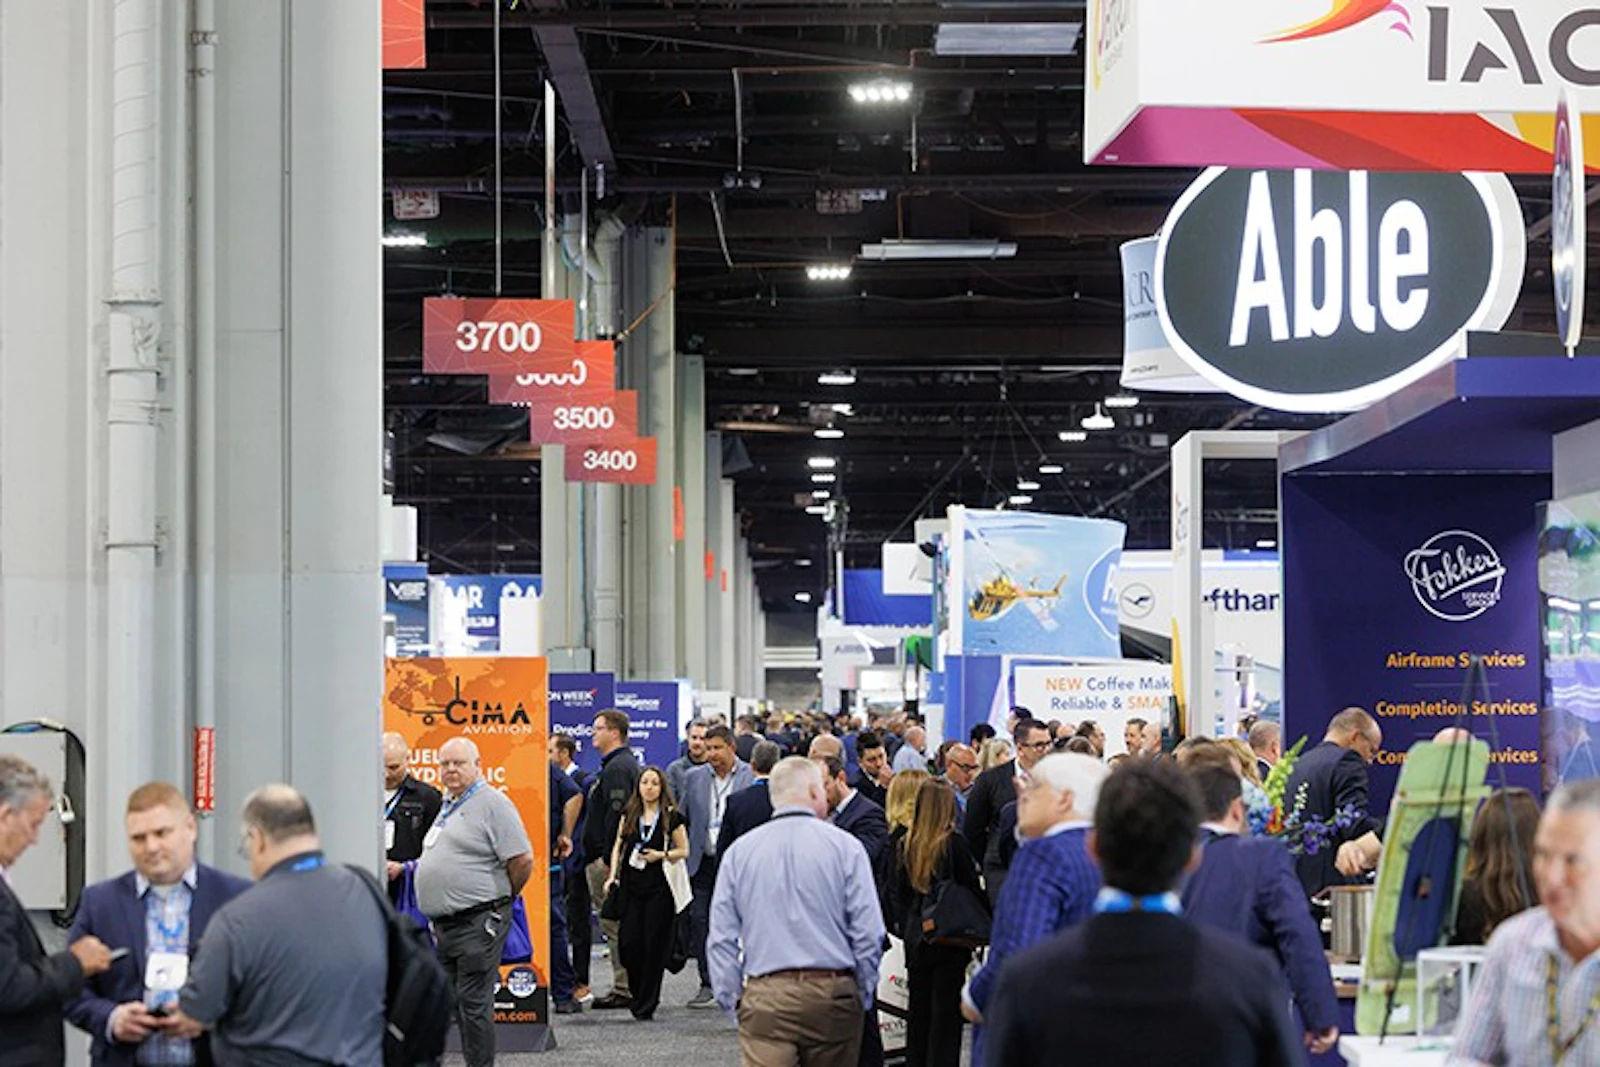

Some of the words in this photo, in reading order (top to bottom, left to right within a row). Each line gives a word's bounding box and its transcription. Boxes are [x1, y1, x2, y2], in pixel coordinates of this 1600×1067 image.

[1229, 168, 1430, 346] Able
[456, 322, 541, 351] 3700
[553, 407, 615, 429] 3500
[583, 450, 637, 471] 3400
[1404, 545, 1500, 600] Fokker
[1204, 587, 1279, 611] ftha
[1386, 652, 1455, 668] Airframe
[1459, 651, 1526, 667] Srvices
[1045, 677, 1082, 690] NEW
[1086, 677, 1135, 691] Coffee
[1140, 677, 1173, 690] Mak
[446, 700, 530, 725] CIMA
[1051, 697, 1107, 710] Reliable
[1112, 697, 1122, 710] &
[1376, 699, 1467, 718] Completion
[462, 724, 532, 734] AVIATION
[406, 749, 440, 764] UEL
